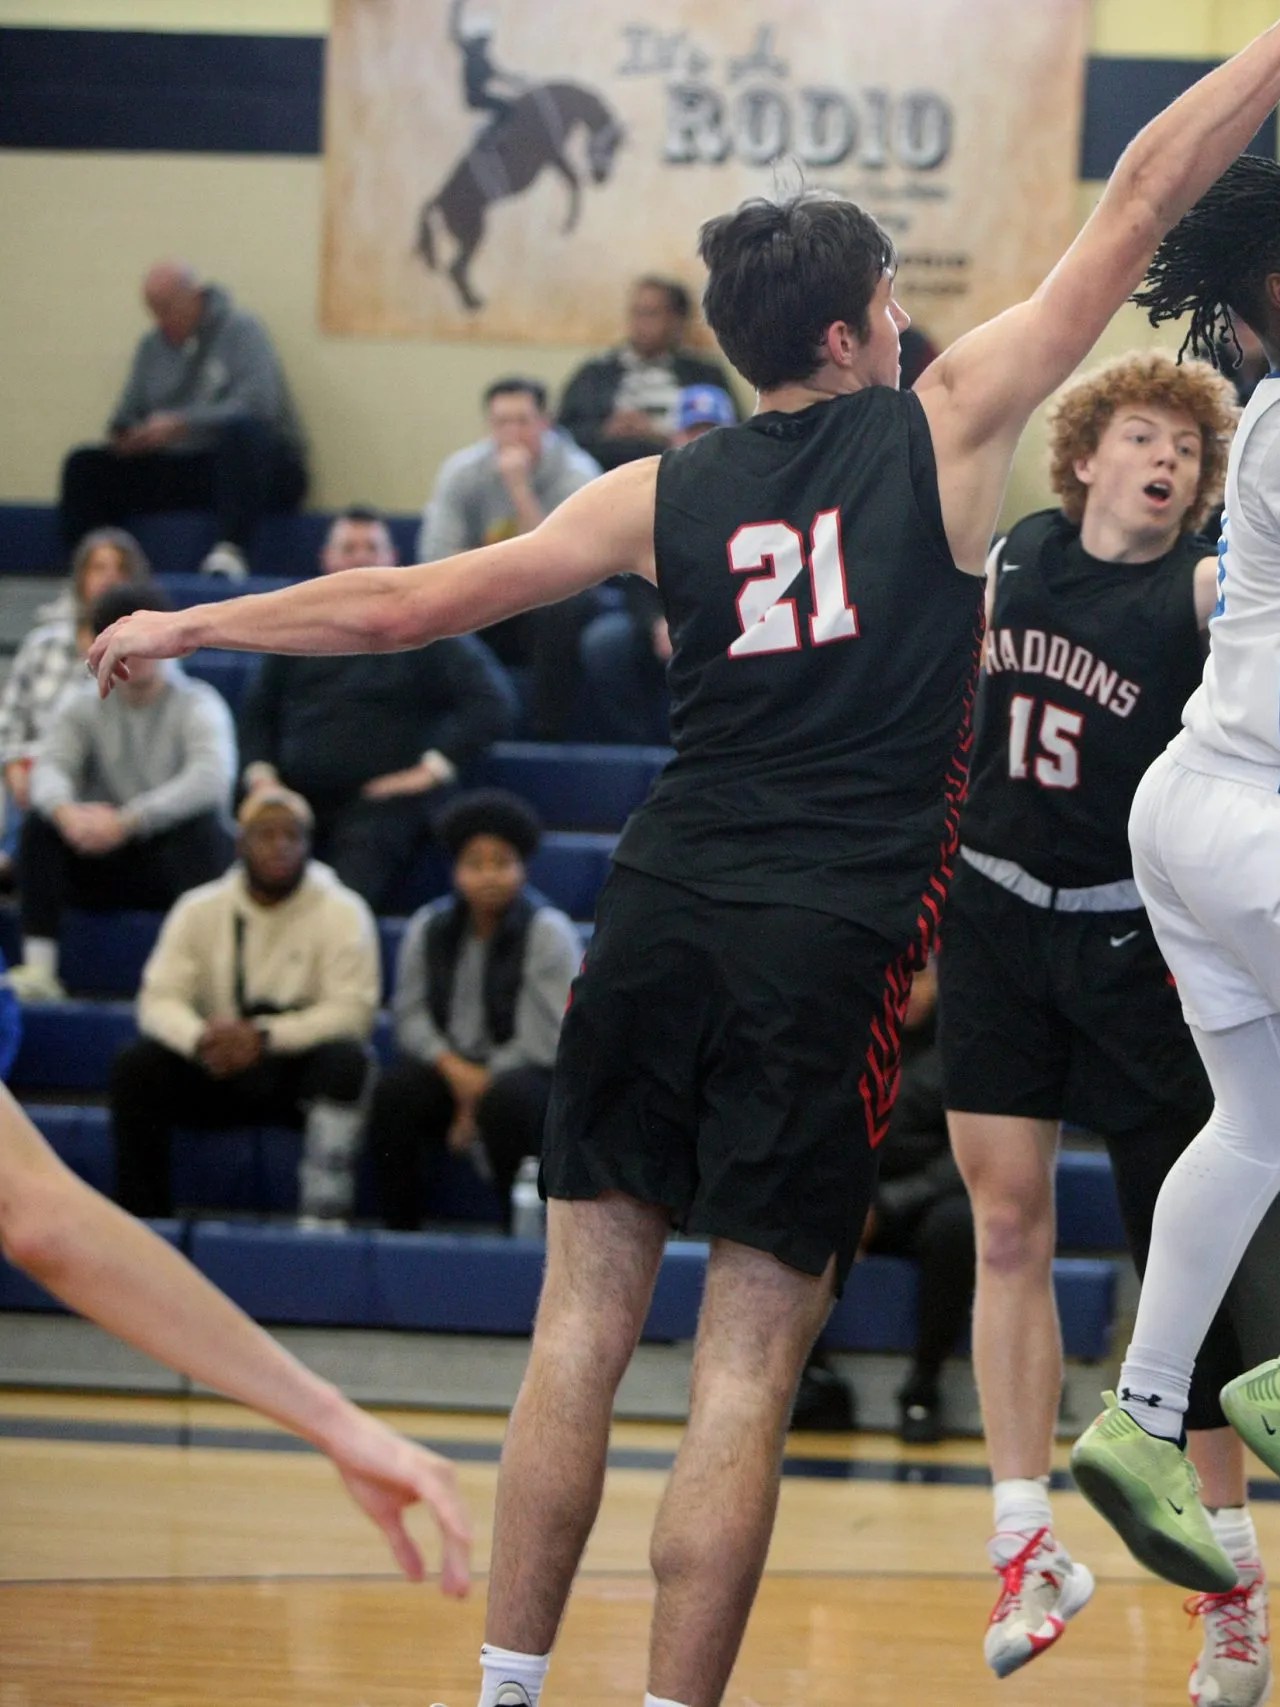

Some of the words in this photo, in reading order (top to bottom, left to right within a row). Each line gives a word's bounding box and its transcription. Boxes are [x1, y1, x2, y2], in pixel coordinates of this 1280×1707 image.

[664, 84, 955, 172] RODIO
[728, 505, 860, 660] 21
[983, 627, 1142, 719] HADDONS
[1008, 692, 1085, 790] 15
